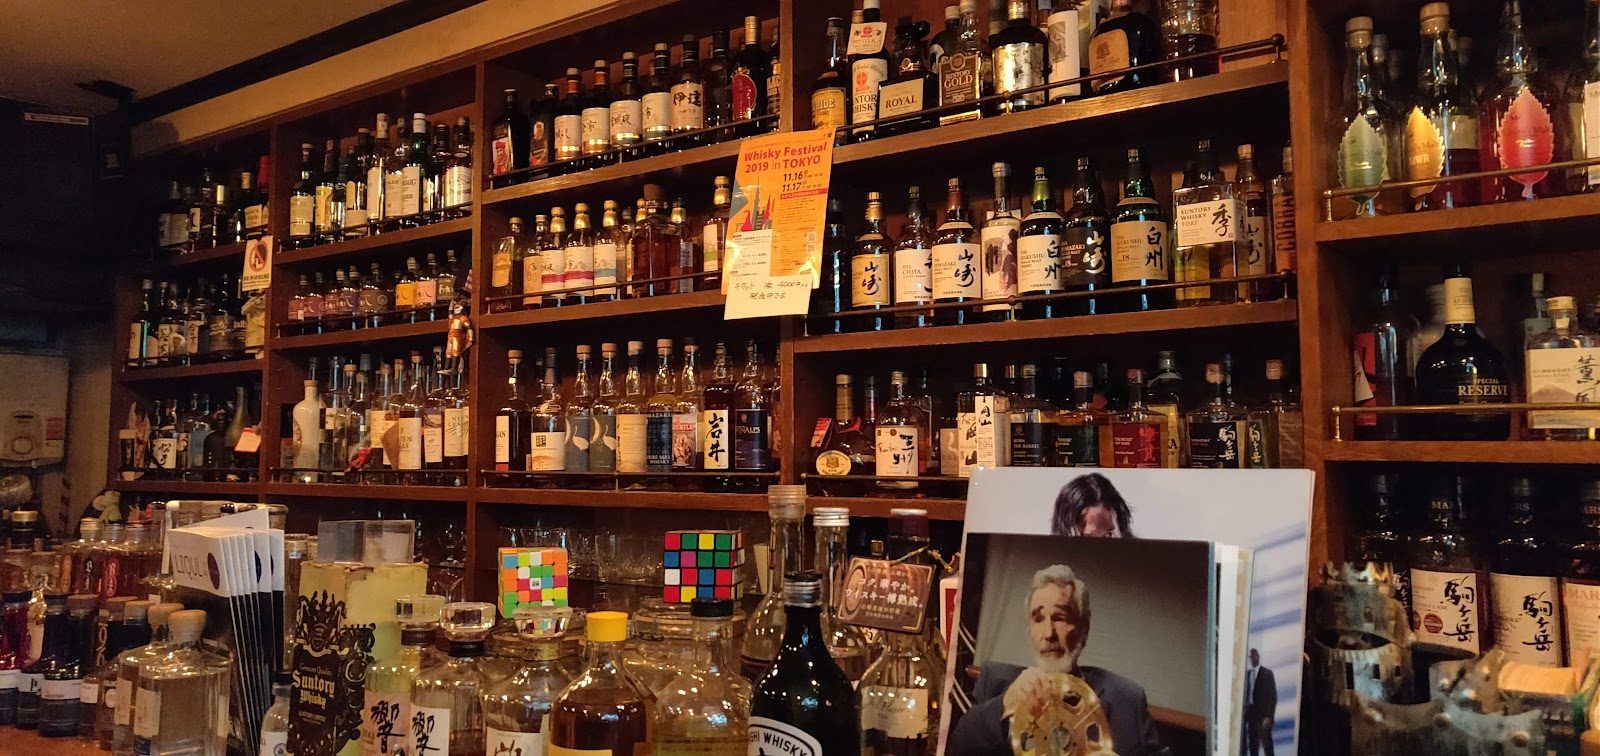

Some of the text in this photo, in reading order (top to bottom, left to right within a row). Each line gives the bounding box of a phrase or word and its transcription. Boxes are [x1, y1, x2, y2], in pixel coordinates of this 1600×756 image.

[944, 75, 973, 88] GOLD
[886, 95, 917, 108] ROYAL
[744, 141, 827, 162] Whisky Festival
[745, 155, 820, 173] 2019 in TOKYO
[782, 182, 801, 192] 11.17
[783, 171, 803, 181] 11.16
[1181, 206, 1211, 215] SUNTORY
[1181, 213, 1206, 221] WHISKY
[1045, 240, 1060, 280] 白州
[1082, 231, 1106, 274] 山崎
[1145, 226, 1163, 271] 白州
[862, 261, 882, 296] 山崎
[955, 249, 976, 287] 山崎
[1458, 385, 1508, 396] RESERVE
[706, 413, 725, 462] 岩井
[1441, 576, 1475, 642] 駒ヶ岳
[1520, 591, 1553, 651] 駒ヶ岳
[292, 670, 335, 698] Suntory
[764, 731, 807, 756] WHISKY
